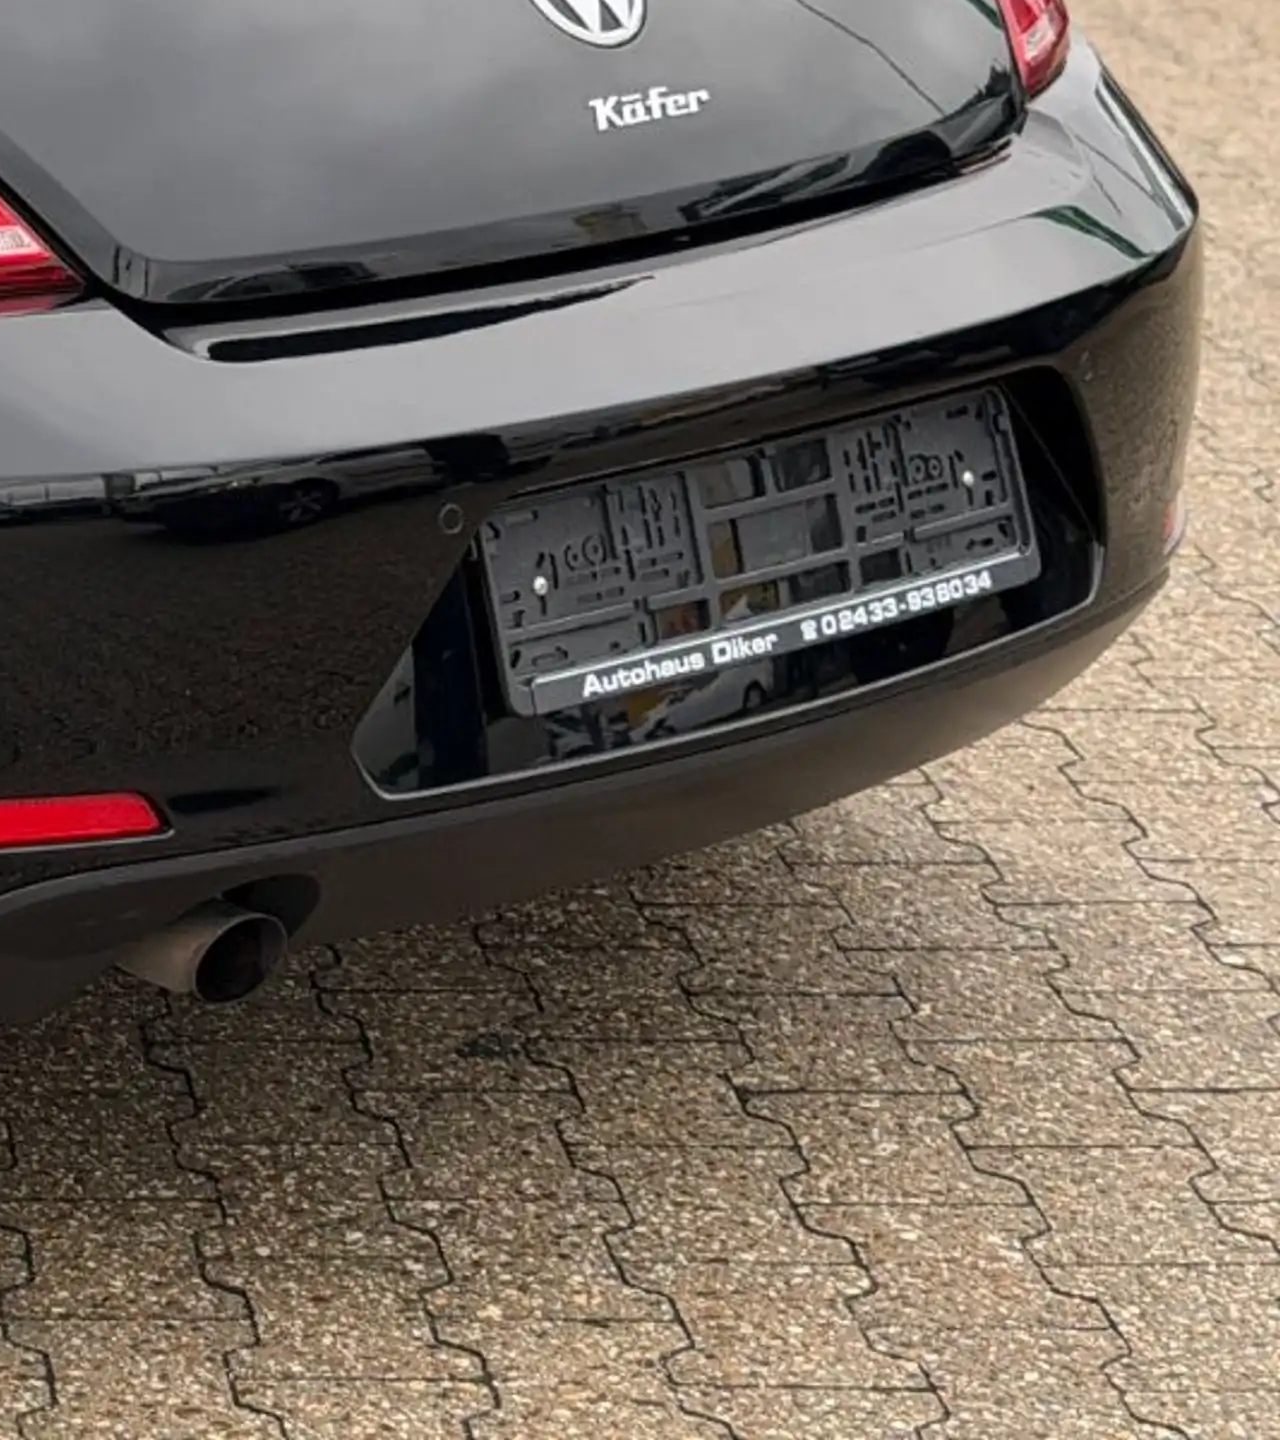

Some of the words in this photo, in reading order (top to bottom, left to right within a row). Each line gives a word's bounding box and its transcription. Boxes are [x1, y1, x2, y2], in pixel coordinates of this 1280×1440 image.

[588, 85, 711, 132] Käfer
[581, 650, 706, 698] Autohaus
[711, 632, 779, 665] Diker
